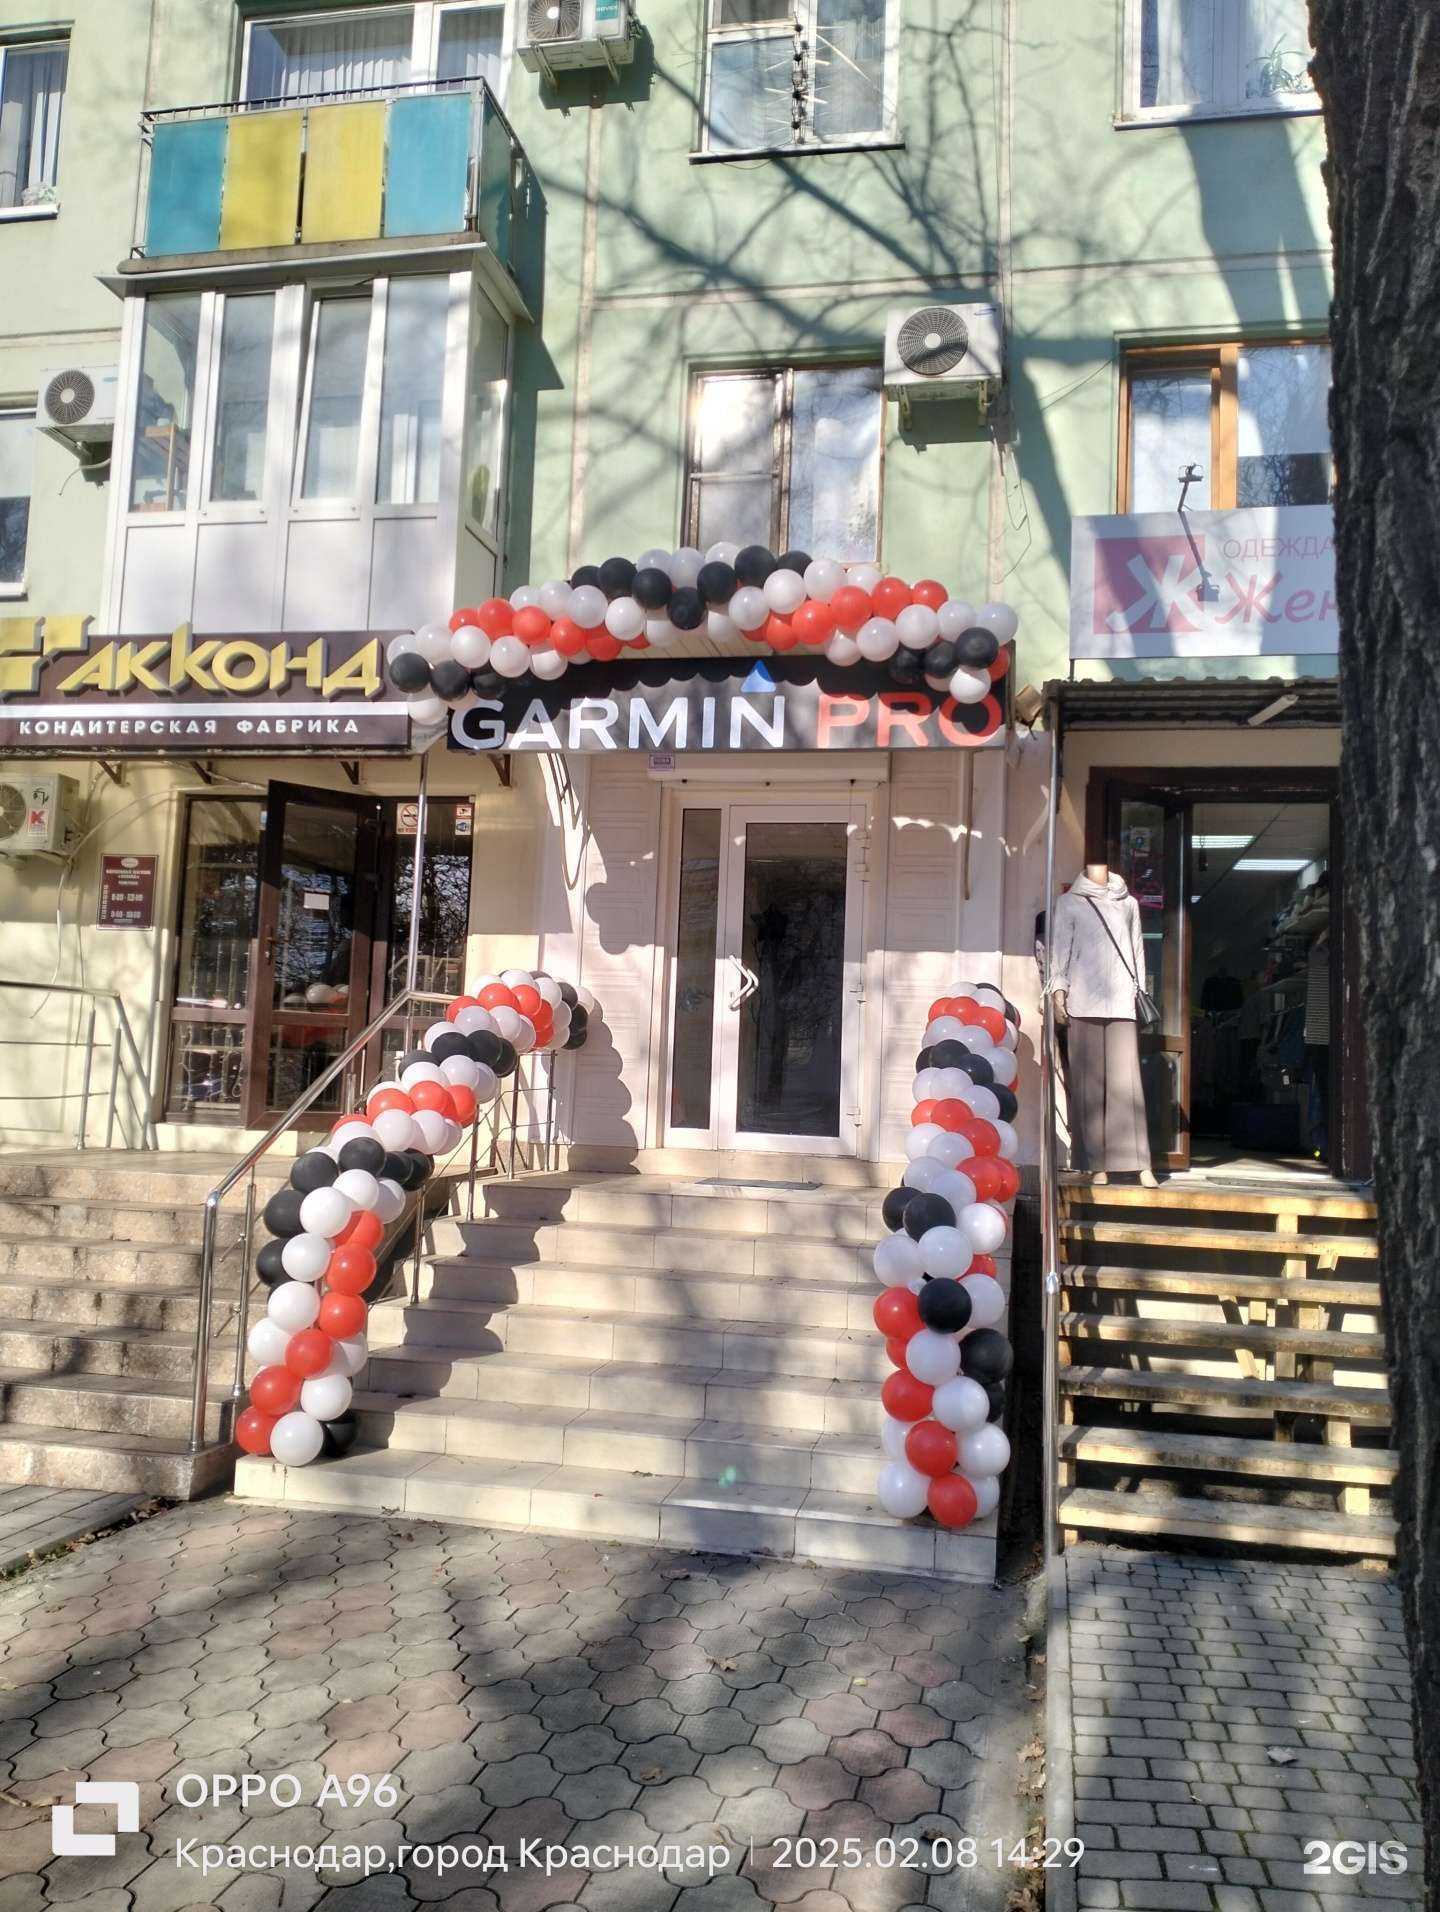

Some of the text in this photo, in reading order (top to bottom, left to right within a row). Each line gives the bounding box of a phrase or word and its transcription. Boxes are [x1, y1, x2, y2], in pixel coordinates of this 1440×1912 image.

[1223, 535, 1337, 560] ОДЕЖДА
[56, 621, 384, 698] АККОНД
[18, 717, 360, 737] КОНДИТЕРСКАЯ ФАБРИКА
[451, 692, 1003, 750] GARMIN PRO
